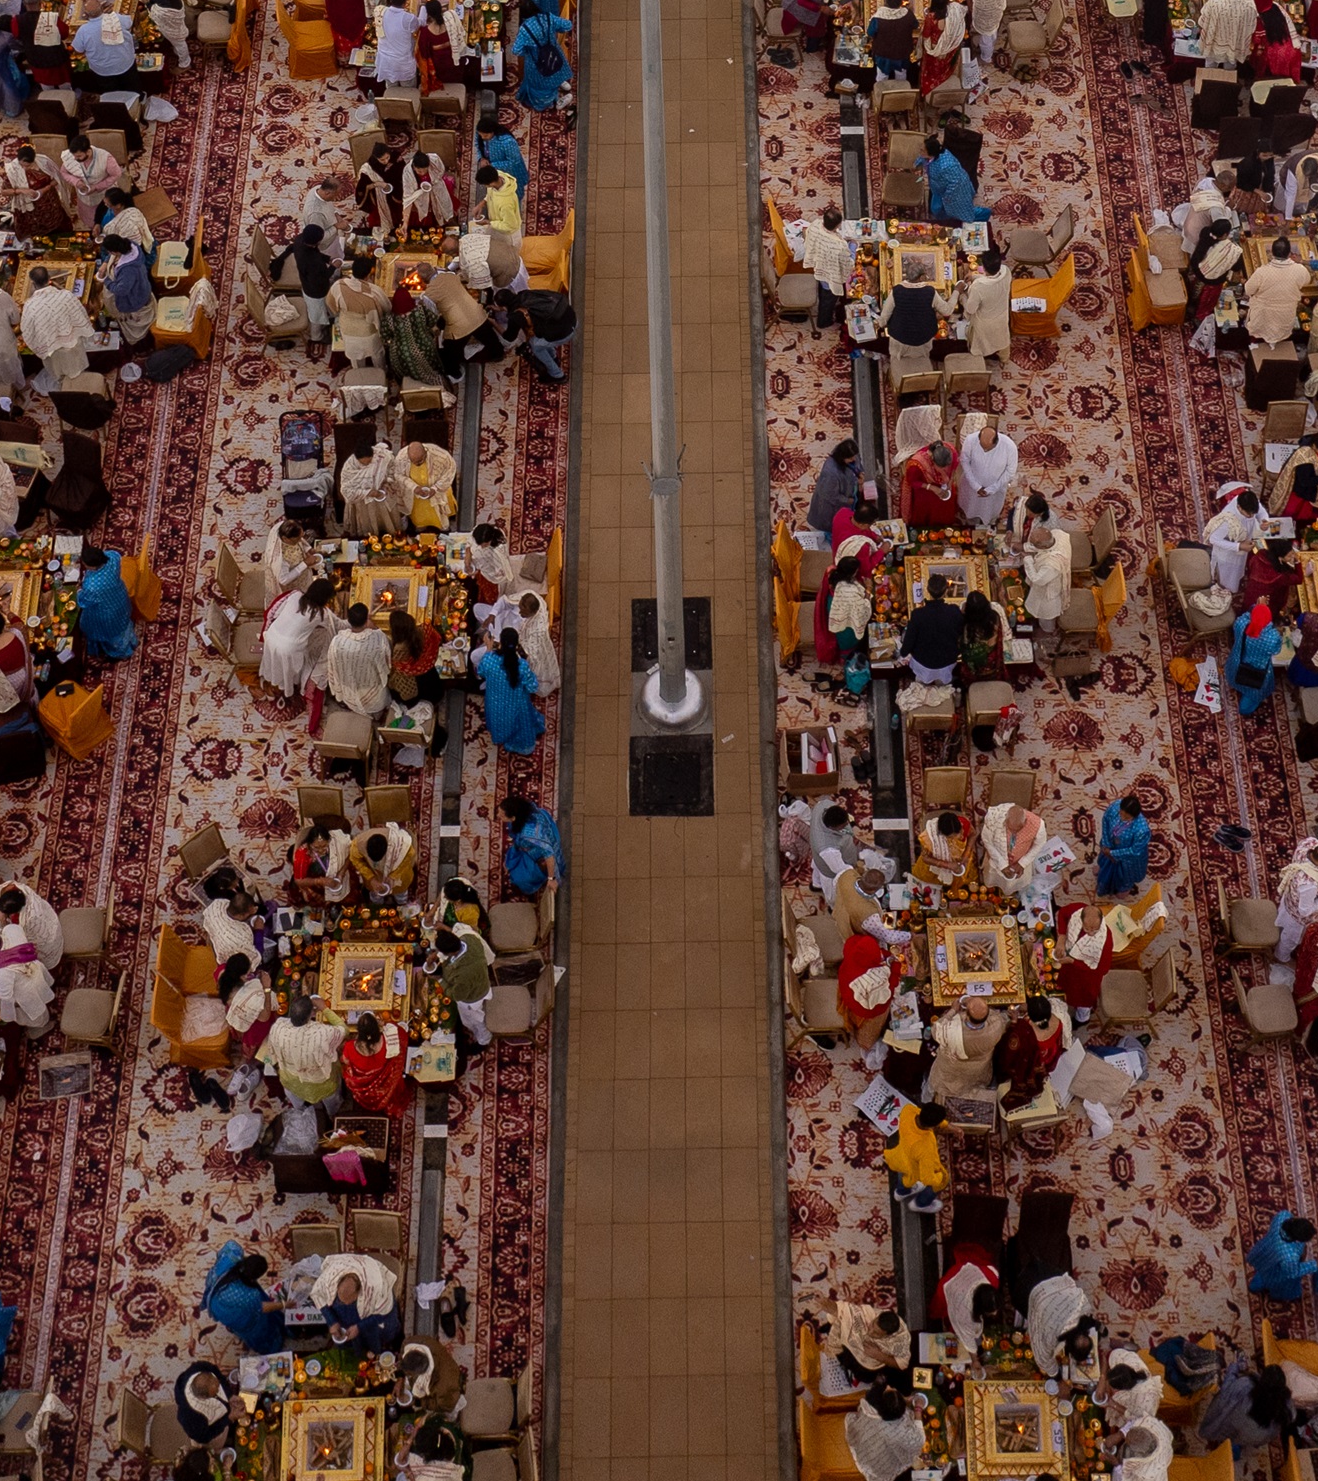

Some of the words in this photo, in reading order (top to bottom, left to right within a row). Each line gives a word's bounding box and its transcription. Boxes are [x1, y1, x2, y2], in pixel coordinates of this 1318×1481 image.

[1038, 853, 1053, 864] UAE
[937, 952, 946, 963] F5
[290, 1313, 294, 1321] I
[307, 1313, 323, 1321] UAE
[1054, 1430, 1062, 1444] G5
